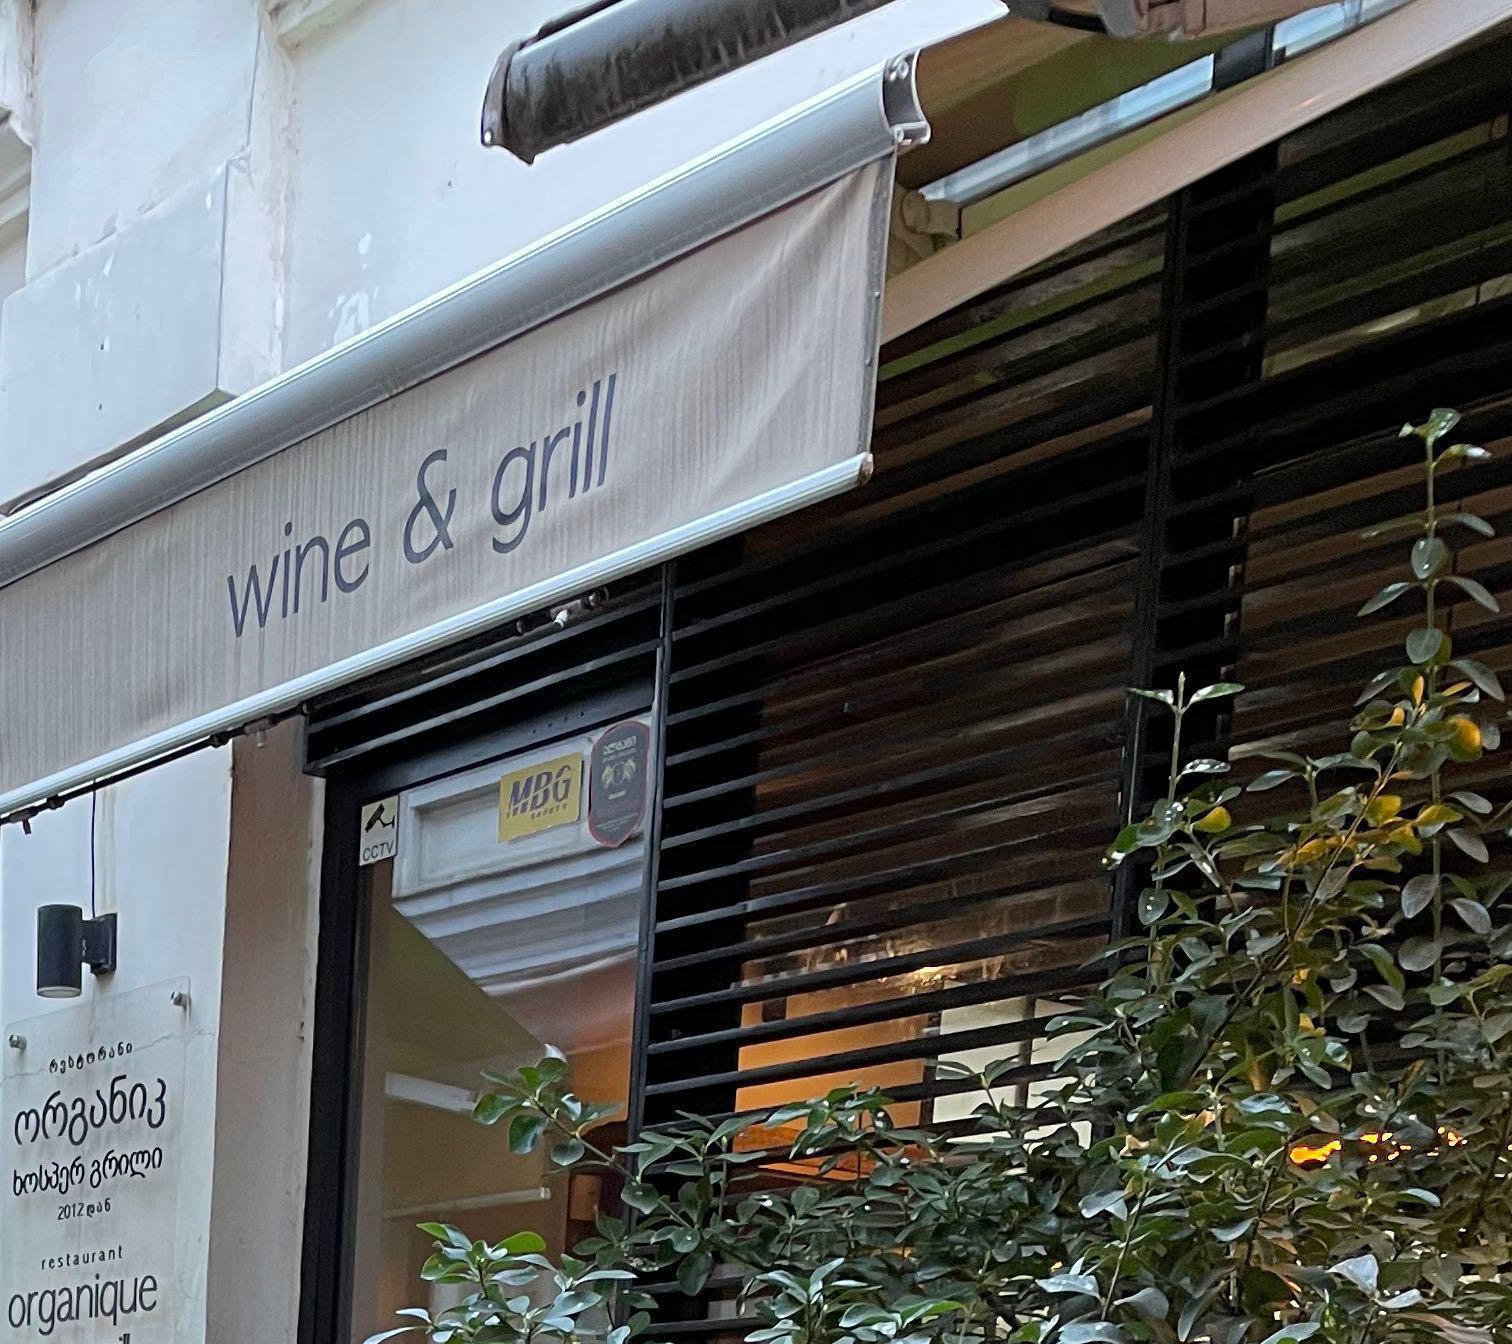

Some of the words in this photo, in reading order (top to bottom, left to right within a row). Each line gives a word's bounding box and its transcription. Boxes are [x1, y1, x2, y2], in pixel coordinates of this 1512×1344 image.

[227, 518, 371, 638] wine
[403, 449, 457, 564] &
[491, 373, 618, 554] grill
[362, 840, 394, 861] CCTV
[49, 1041, 133, 1074] რესტორანი
[14, 1074, 166, 1146] ორგანიკ
[13, 1156, 85, 1196] ხოსპერ
[90, 1147, 163, 1189] გრილი
[41, 1245, 123, 1271] restaurant
[8, 1273, 158, 1336] organique
